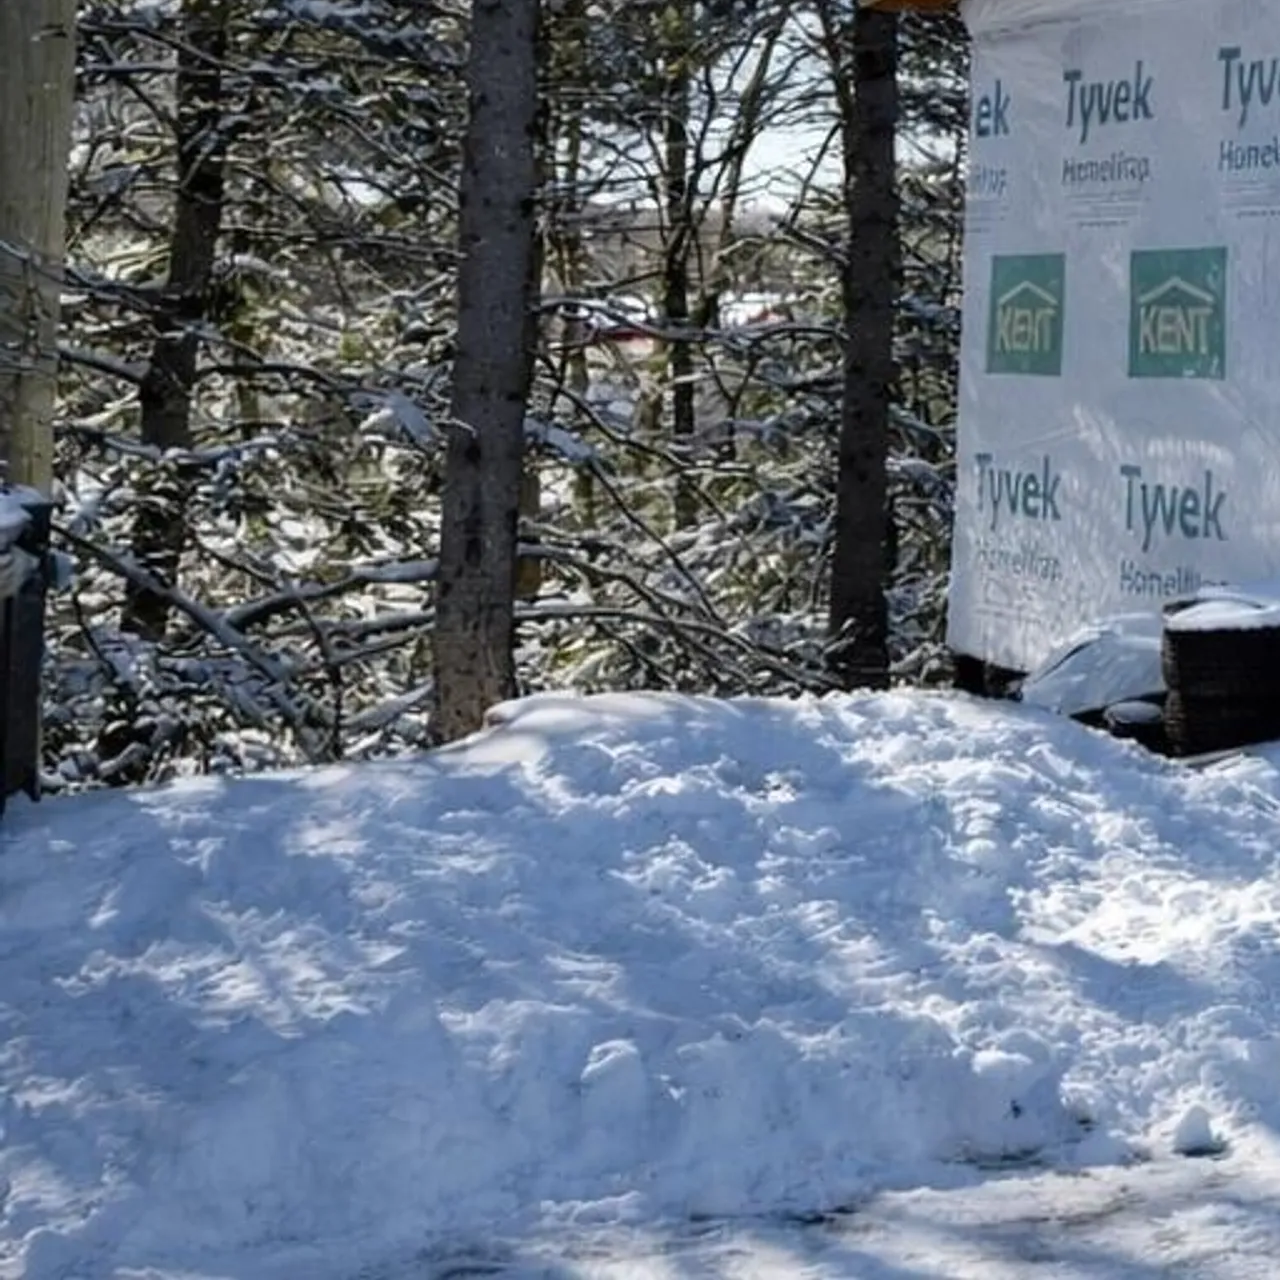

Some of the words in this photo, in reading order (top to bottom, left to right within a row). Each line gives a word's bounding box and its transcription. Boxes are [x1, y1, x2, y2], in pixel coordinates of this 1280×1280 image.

[1062, 60, 1155, 145] Tyvek
[995, 305, 1058, 354] KENT
[1138, 304, 1214, 355] KENT
[975, 453, 1063, 532] Tyvek
[1120, 464, 1230, 553] Tyvek
